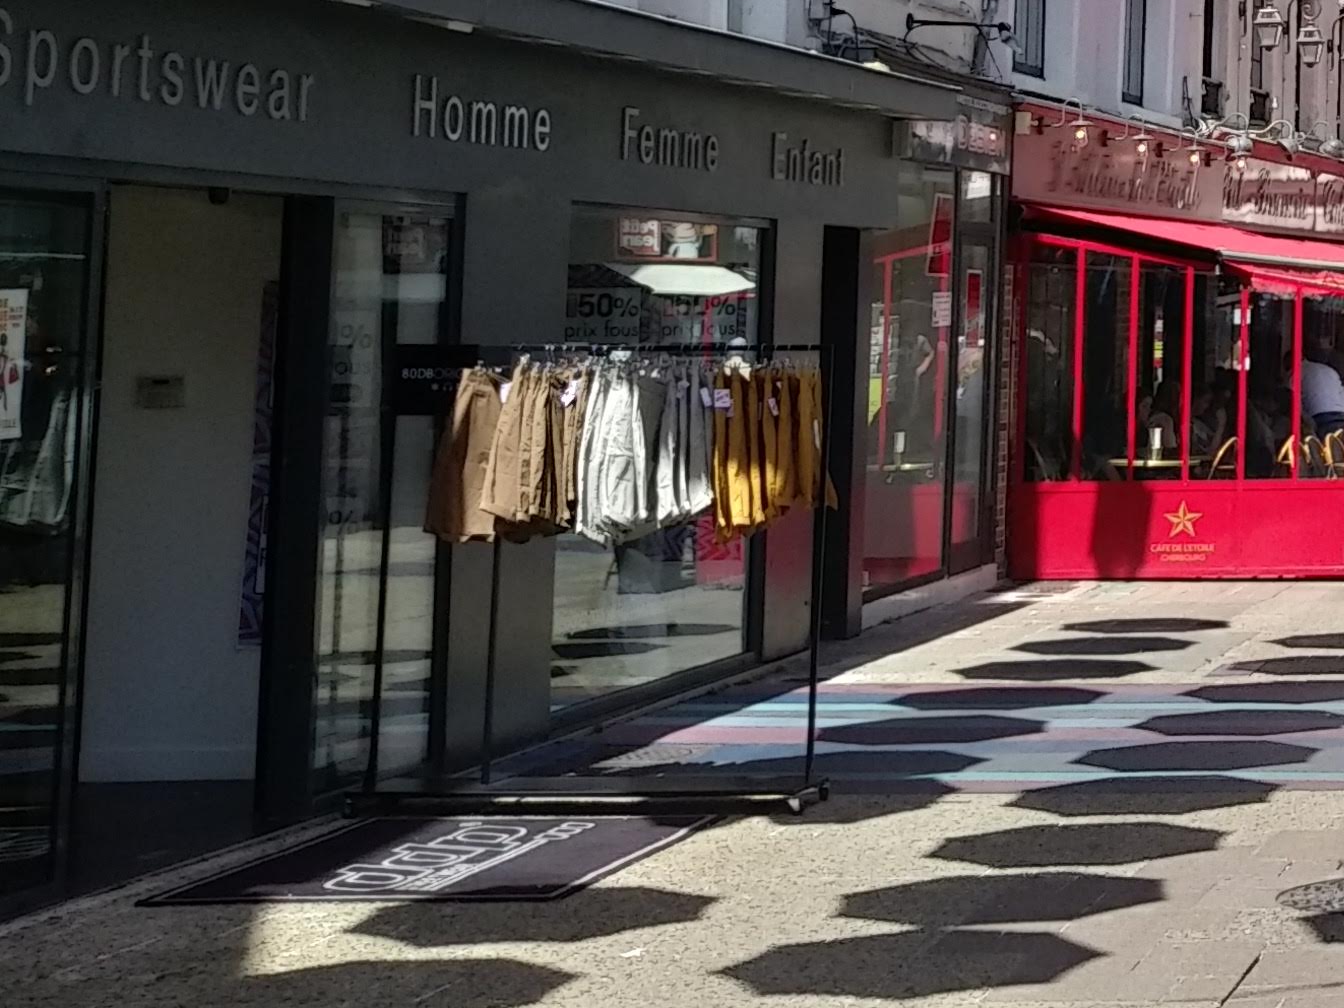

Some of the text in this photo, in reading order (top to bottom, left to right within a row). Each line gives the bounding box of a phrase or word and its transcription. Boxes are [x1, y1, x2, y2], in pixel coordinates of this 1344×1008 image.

[412, 74, 846, 187] Homme Femme Enfant
